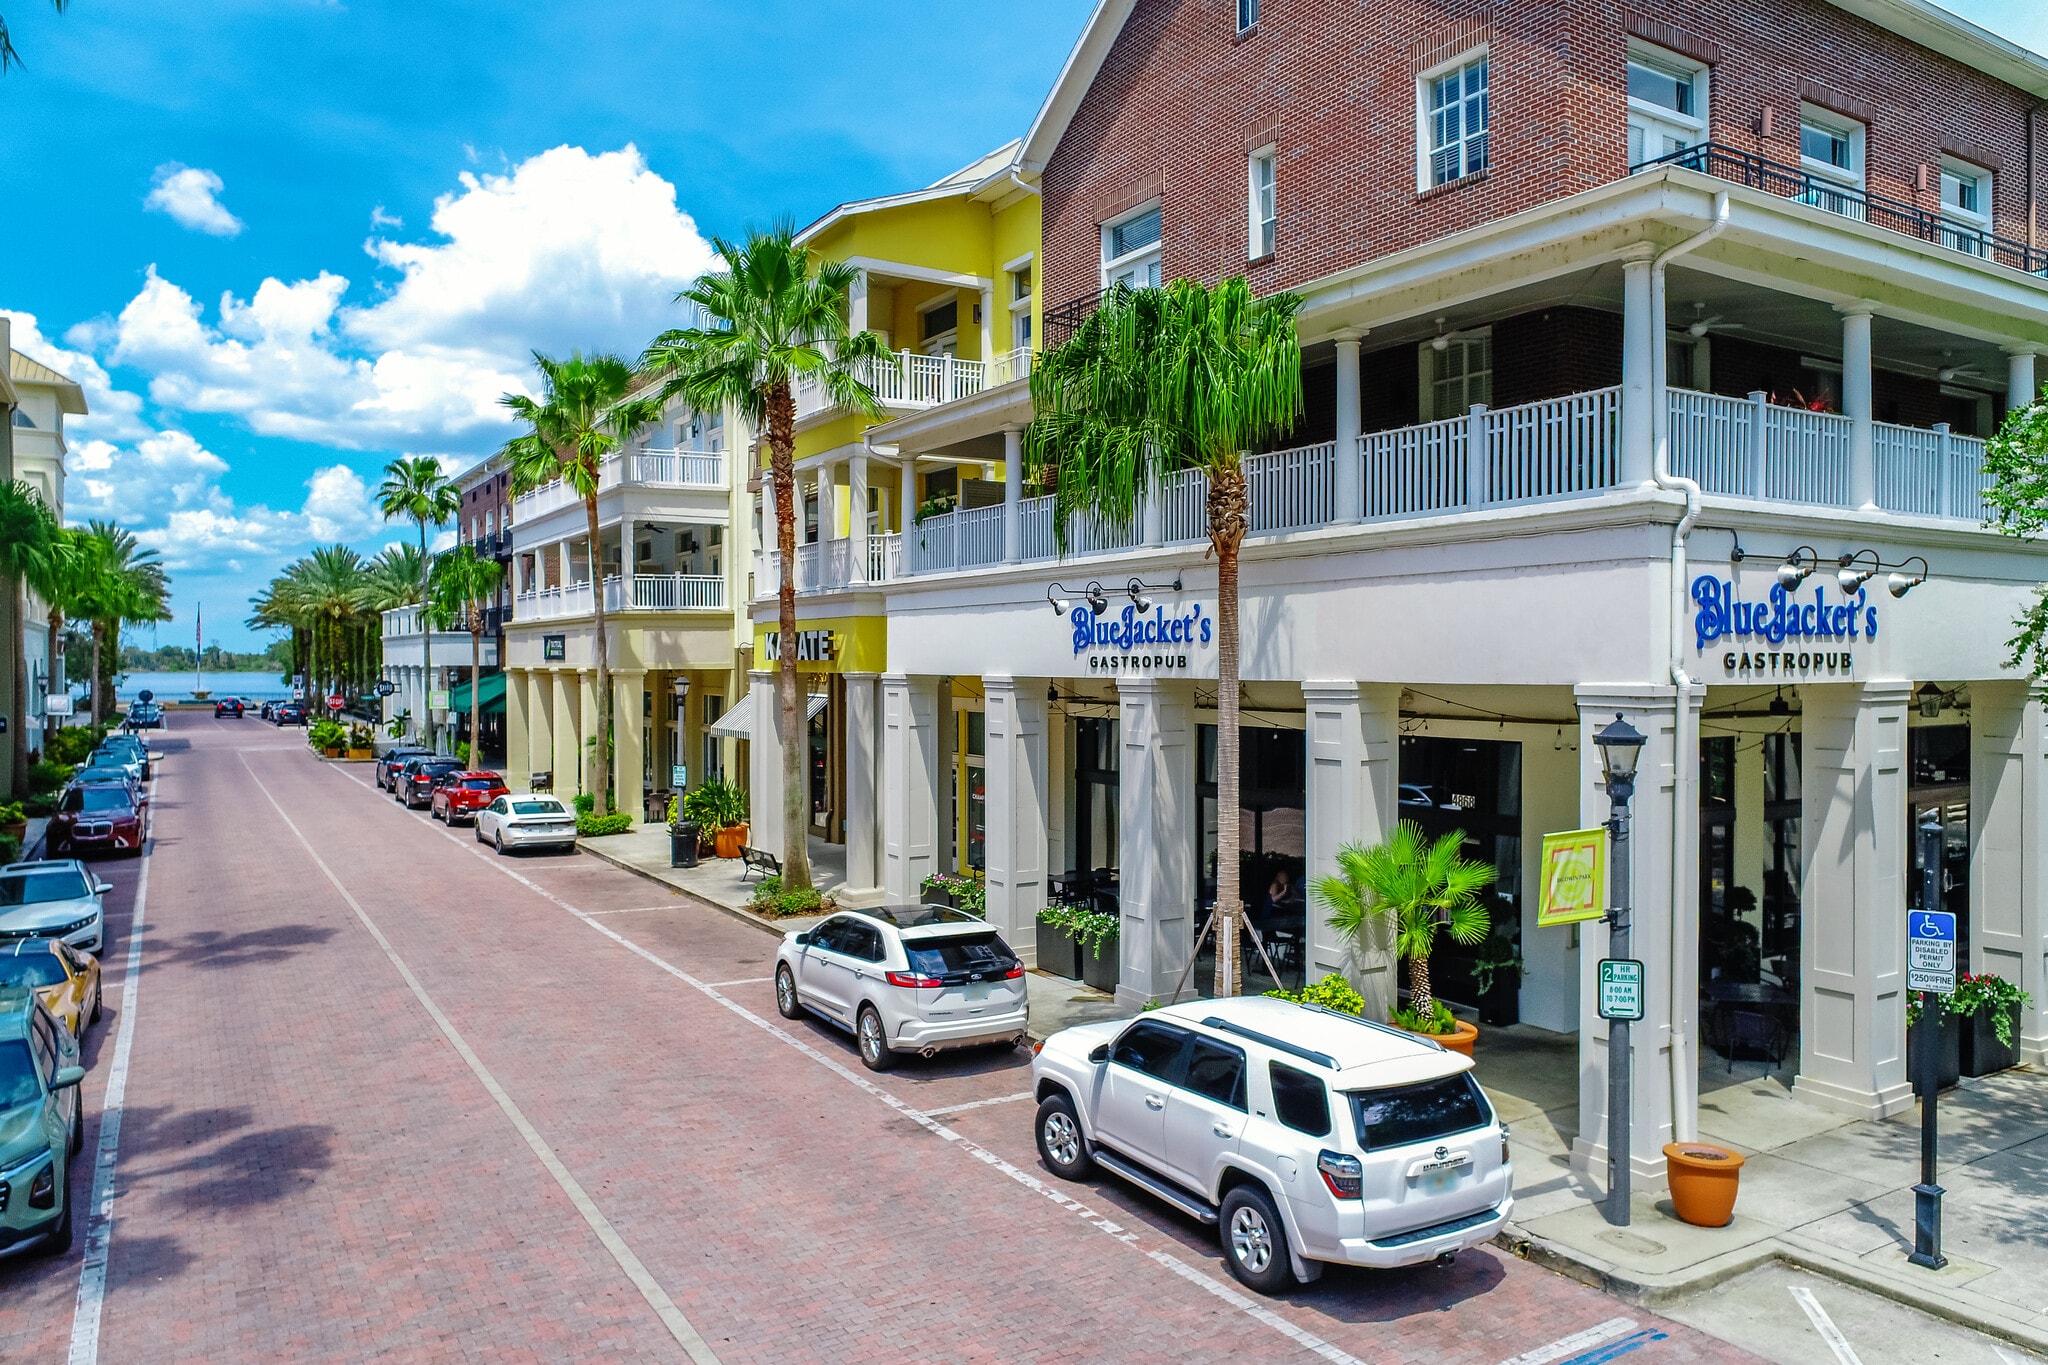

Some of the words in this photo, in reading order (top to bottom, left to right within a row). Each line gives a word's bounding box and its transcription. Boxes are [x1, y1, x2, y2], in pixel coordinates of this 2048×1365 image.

[765, 630, 829, 661] KAATE
[1089, 655, 1187, 668] GASTROPUB
[1723, 652, 1852, 670] GASTROPUB
[1452, 793, 1475, 808] 4868
[1579, 873, 1592, 881] PARK
[1911, 939, 1941, 948] PARKING
[1915, 946, 1949, 955] DISABLED
[1922, 961, 1941, 969] ONLY
[1603, 967, 1612, 981] 2
[1620, 965, 1631, 973] HR
[1613, 974, 1638, 982] PARKING
[1935, 976, 1953, 985] FINE
[1623, 986, 1632, 994] AM
[1606, 995, 1613, 1003] TO
[1627, 996, 1636, 1004] PM
